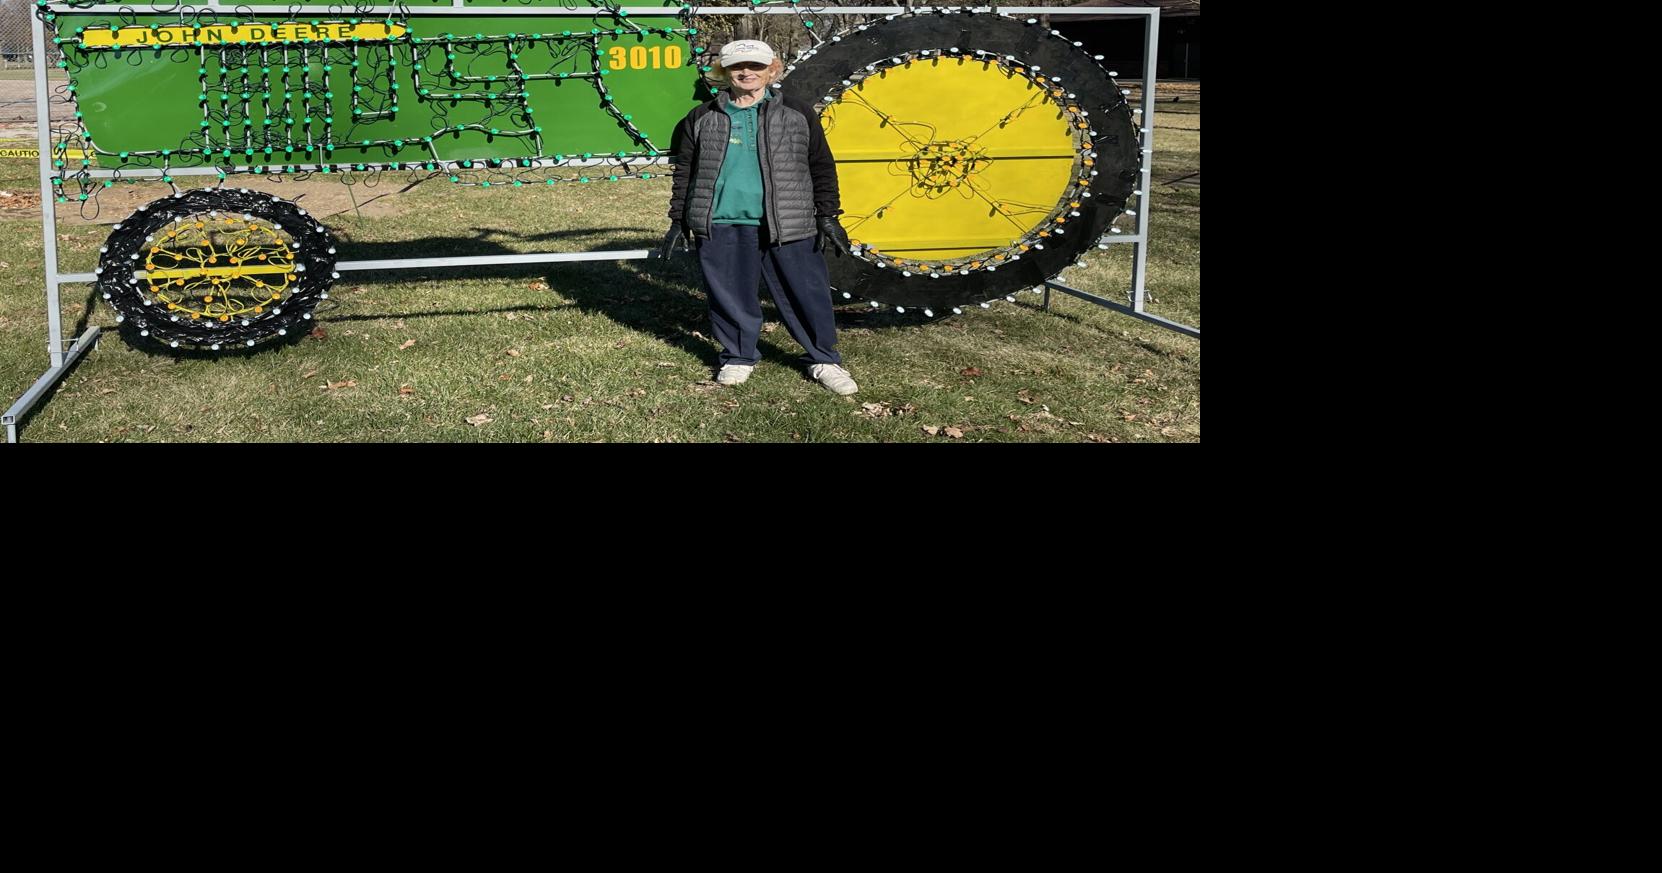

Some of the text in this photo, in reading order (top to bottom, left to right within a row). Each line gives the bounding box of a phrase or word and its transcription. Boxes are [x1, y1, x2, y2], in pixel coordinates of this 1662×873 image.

[136, 26, 351, 43] JOHN DEERE
[608, 45, 682, 70] 3010
[0, 149, 40, 157] CAUTIO
